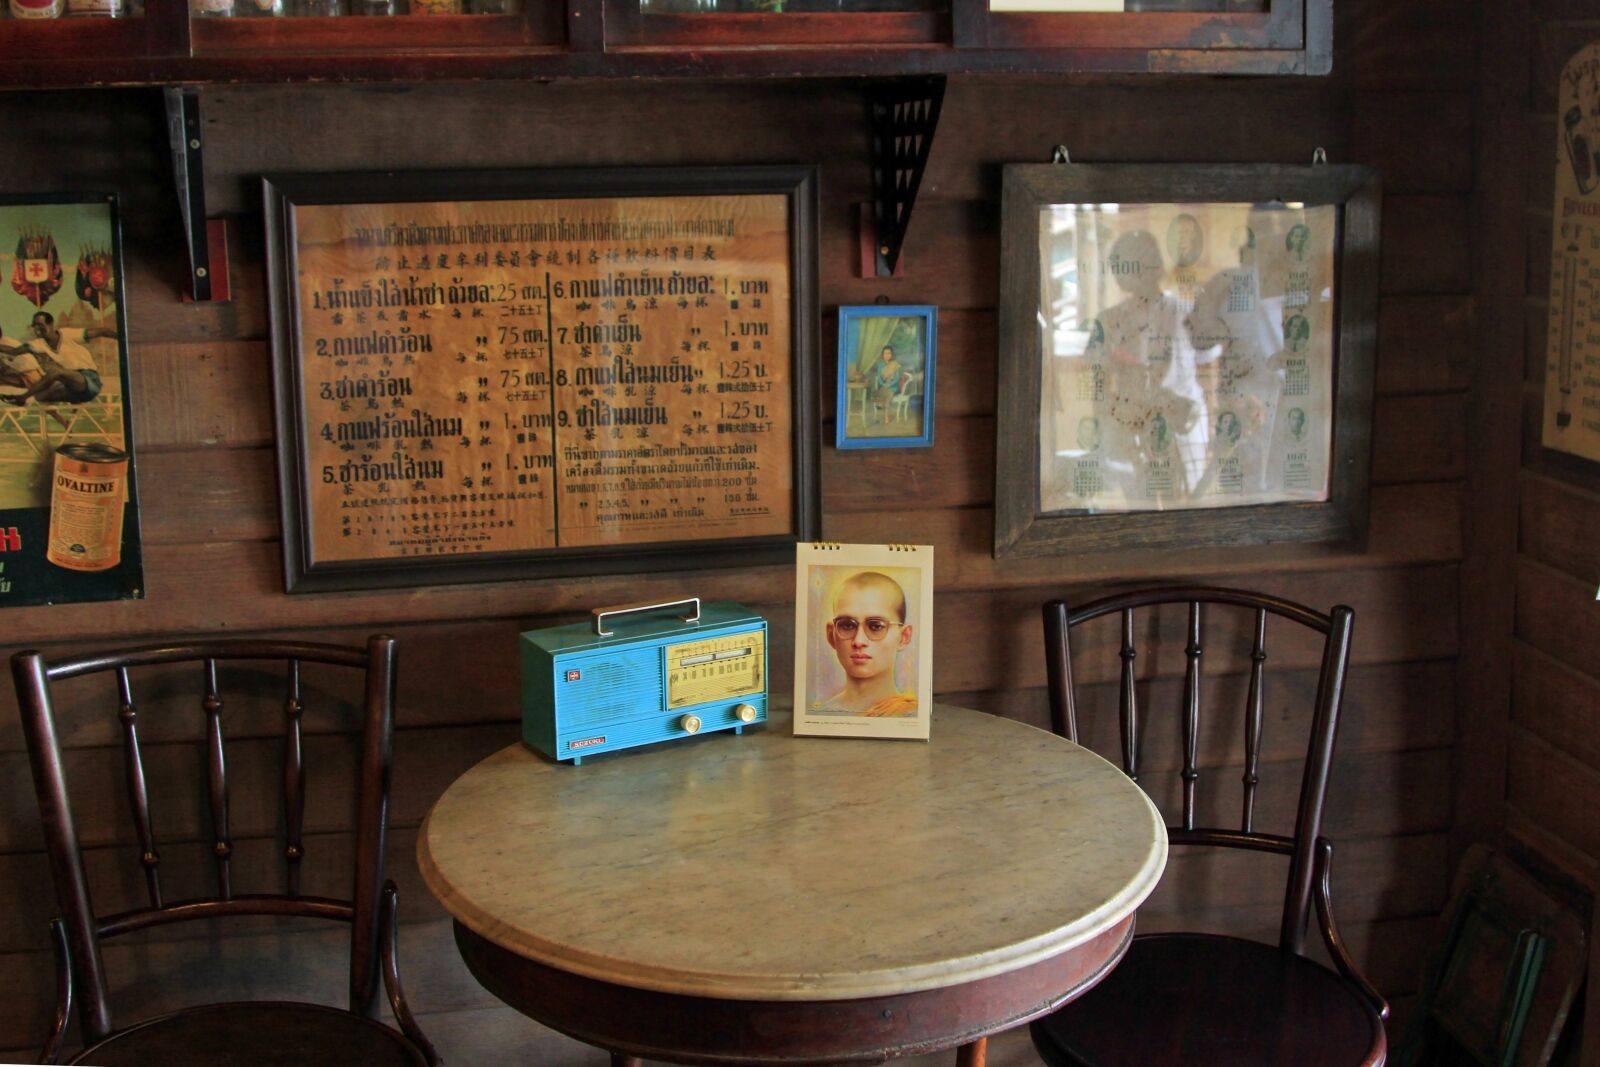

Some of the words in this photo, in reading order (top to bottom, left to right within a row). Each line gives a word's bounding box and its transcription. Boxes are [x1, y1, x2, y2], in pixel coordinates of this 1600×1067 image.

[497, 283, 517, 301] 25
[498, 327, 519, 344] 75
[501, 370, 521, 388] 75
[58, 476, 114, 493] OVALTINE
